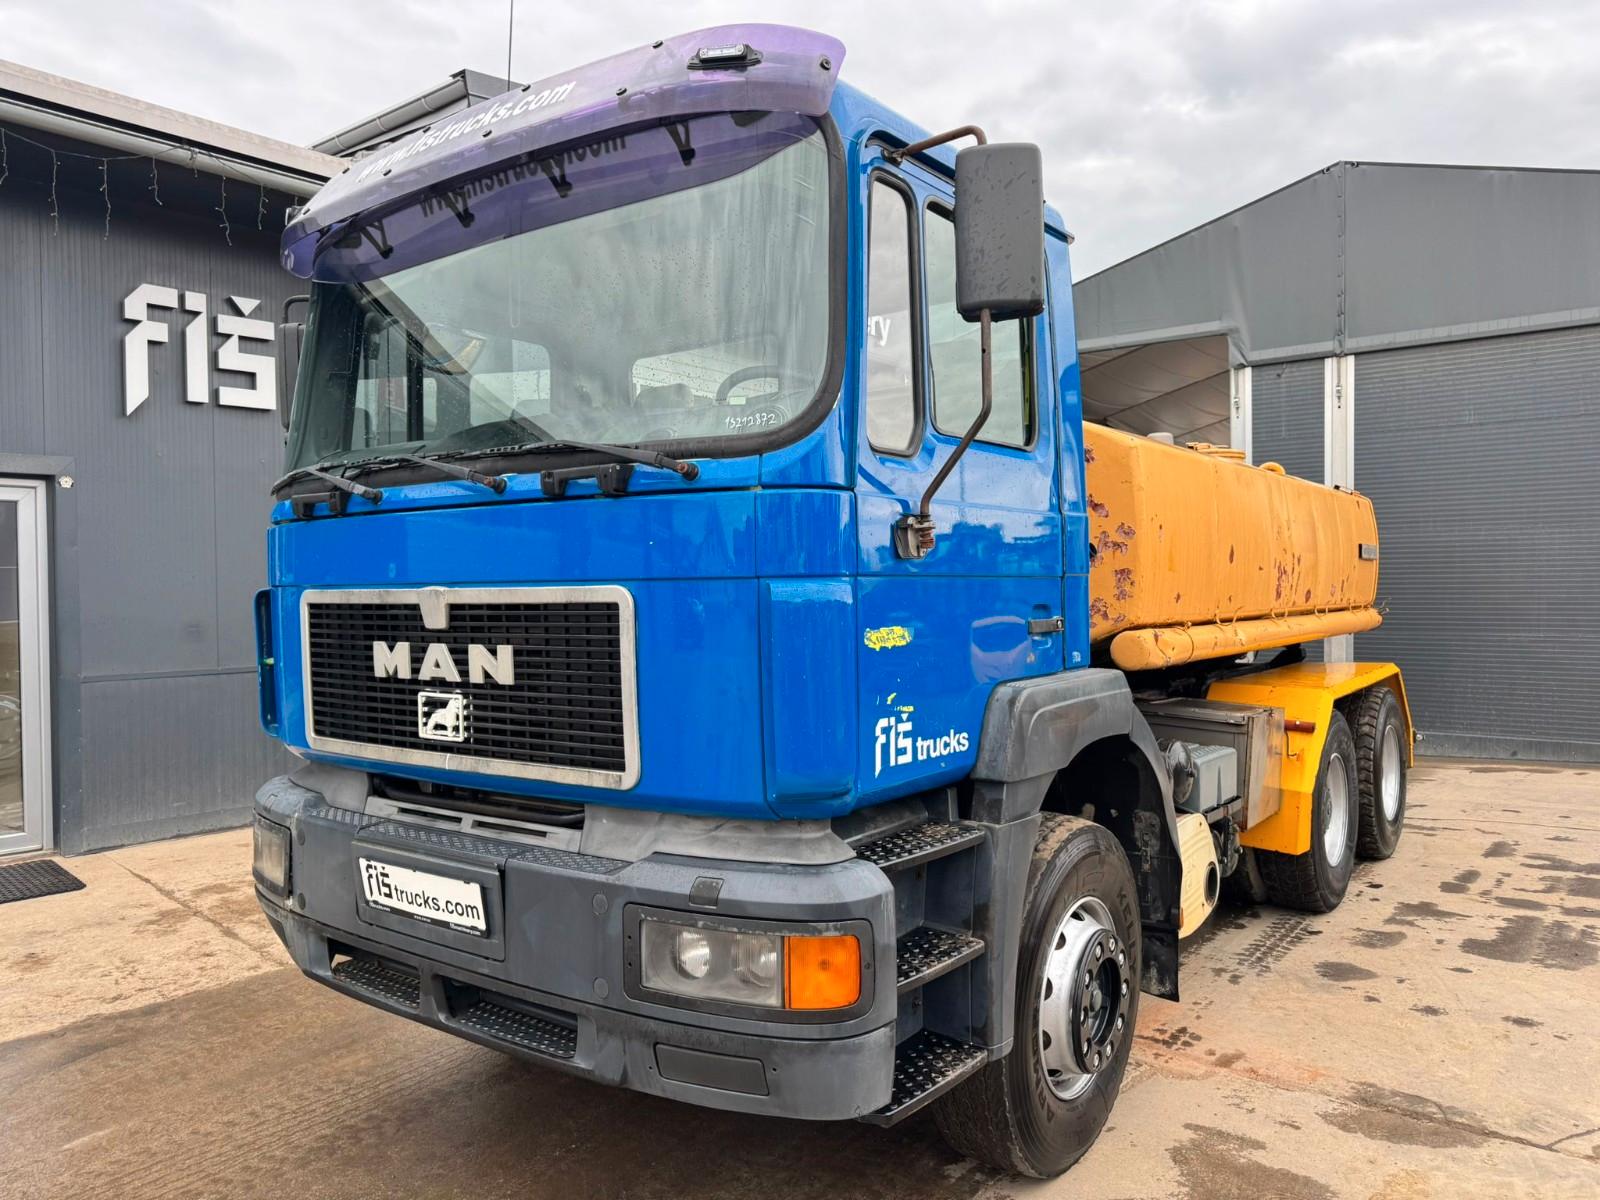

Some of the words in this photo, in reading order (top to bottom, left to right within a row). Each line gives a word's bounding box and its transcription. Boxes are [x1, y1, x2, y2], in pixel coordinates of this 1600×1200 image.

[373, 641, 515, 685] MAN
[916, 728, 969, 761] trucks
[394, 884, 481, 920] trucks.com
